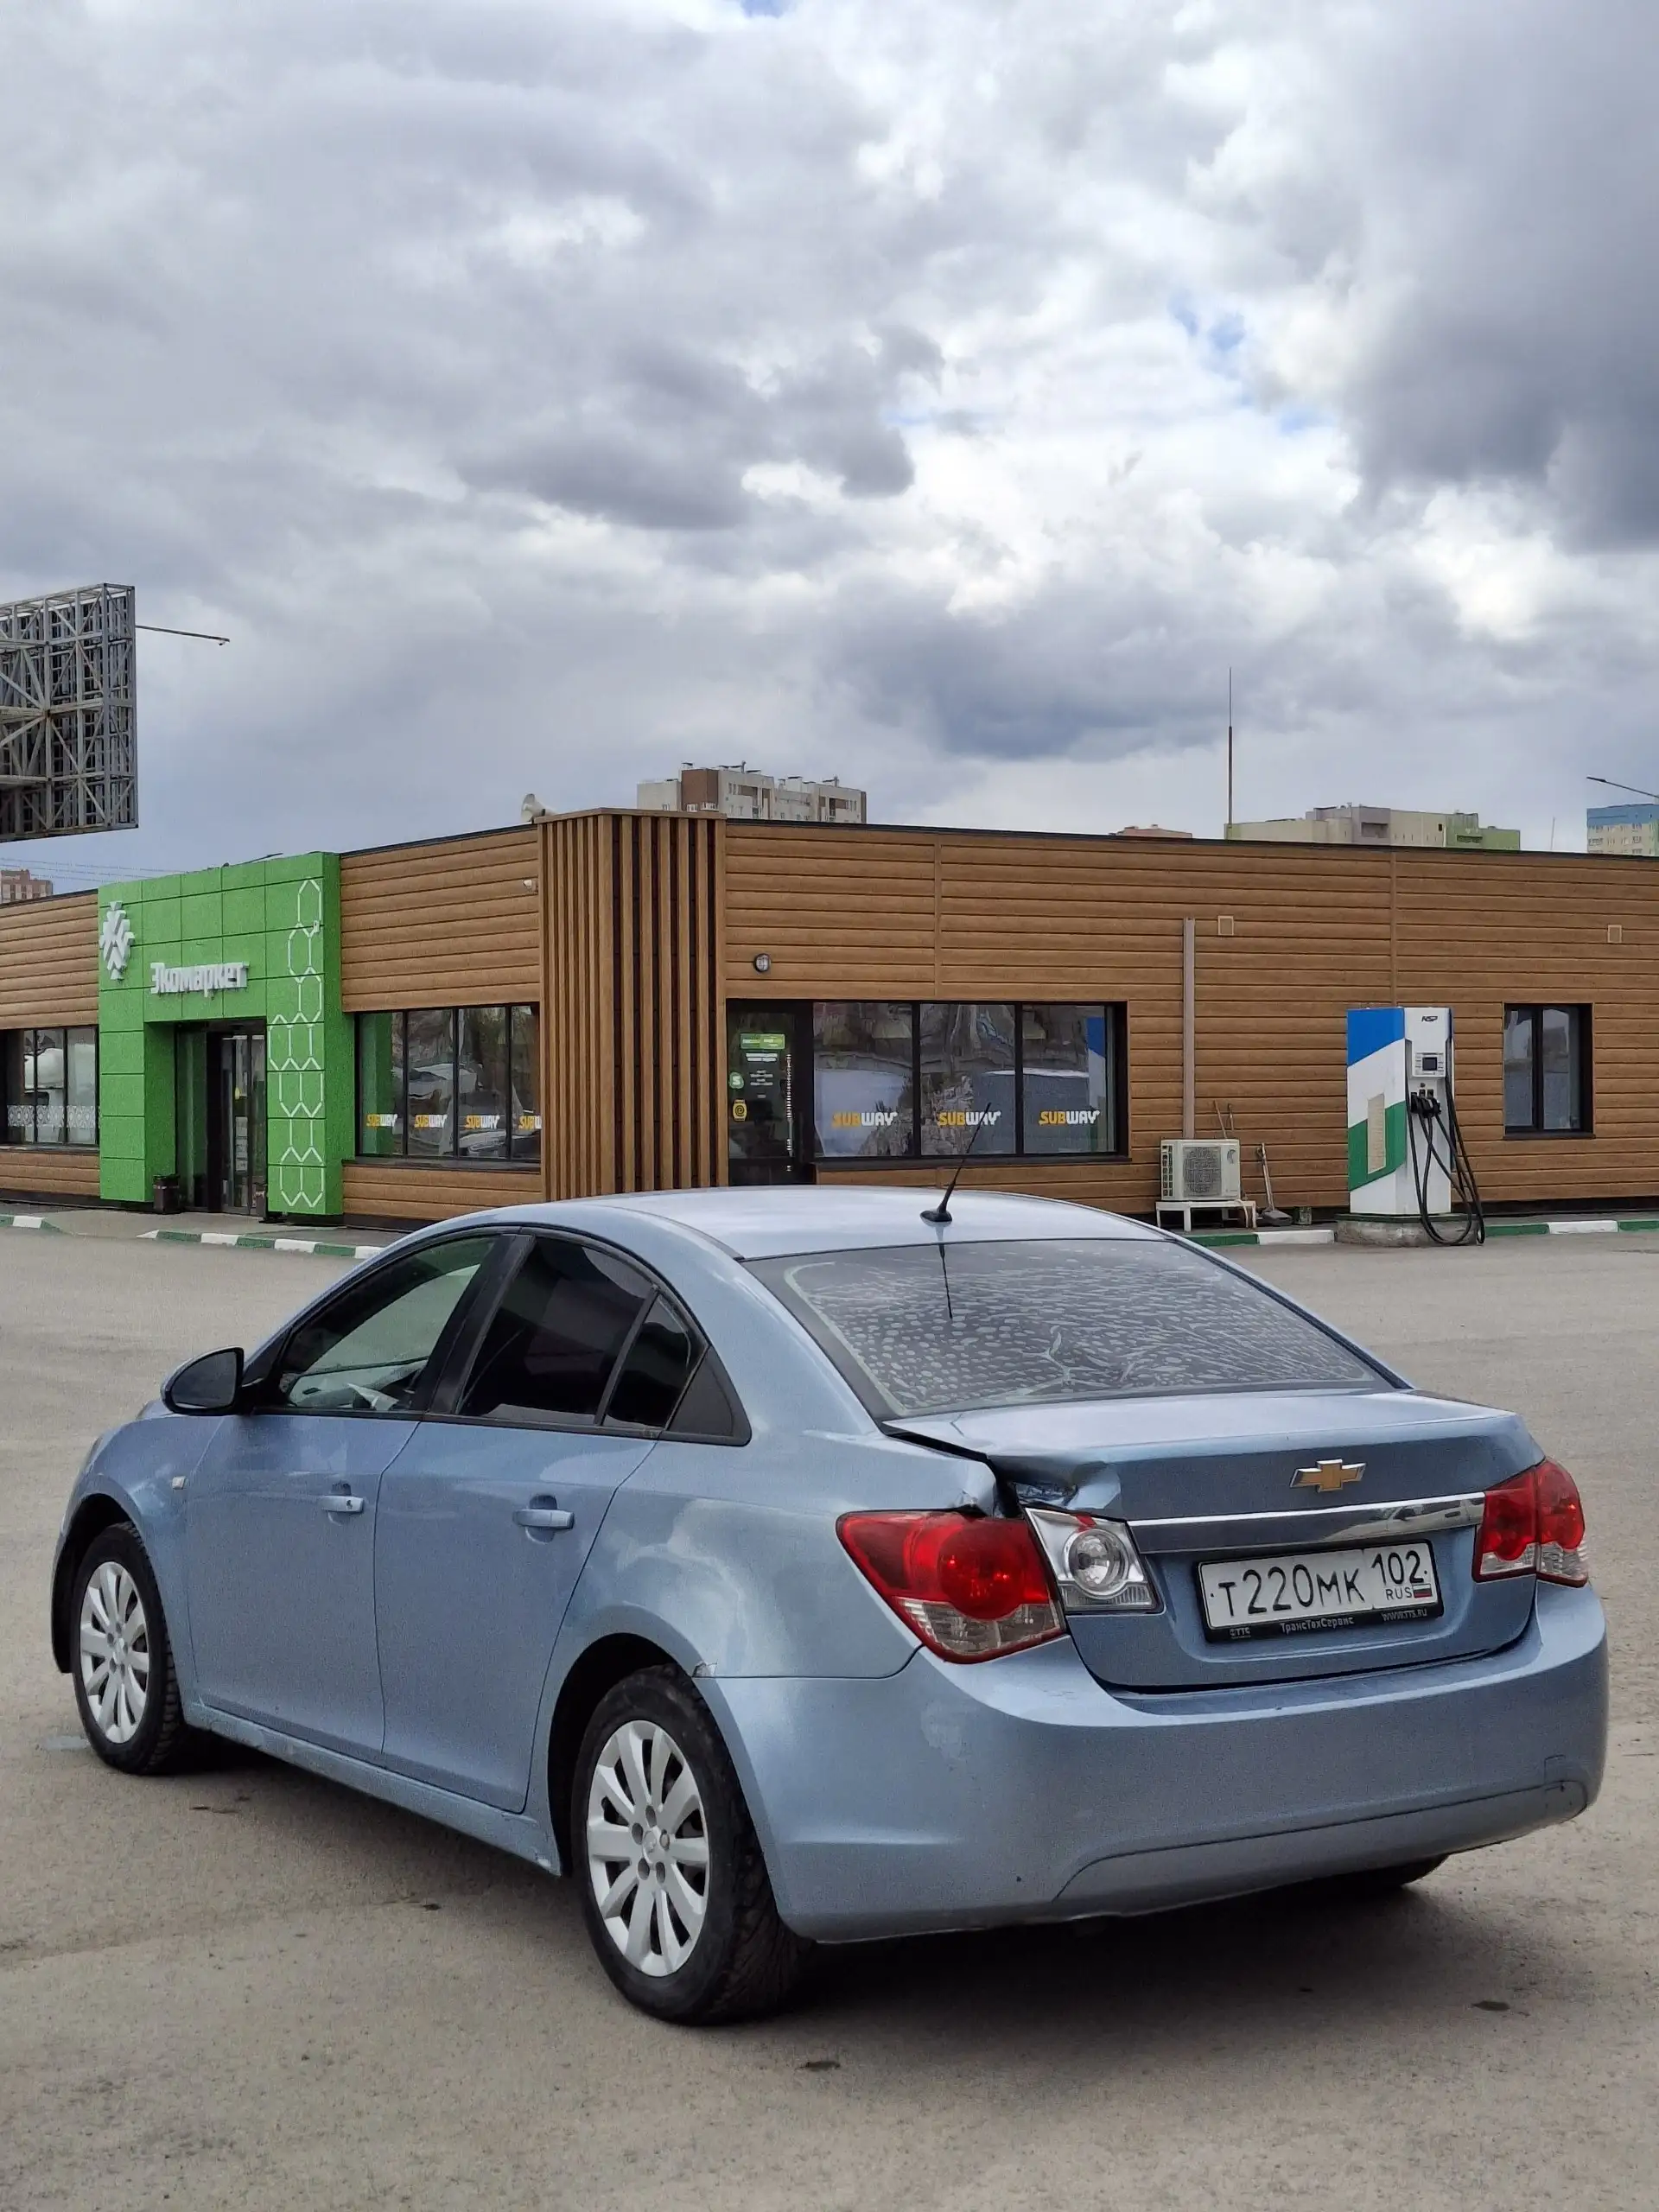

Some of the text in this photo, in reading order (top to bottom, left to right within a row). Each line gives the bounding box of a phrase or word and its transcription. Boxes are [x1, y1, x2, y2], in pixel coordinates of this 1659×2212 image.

[150, 962, 250, 998] Экомаркет
[366, 1113, 398, 1128] SUBWAY
[414, 1113, 448, 1128] SUBWAY
[466, 1114, 500, 1129] SUBWAY
[831, 1111, 898, 1128] SUBWAY
[938, 1110, 1001, 1127] SUBWAY
[1038, 1110, 1100, 1126] SUBWAY
[1370, 1550, 1425, 1586] 102
[1385, 1586, 1413, 1600] RUS
